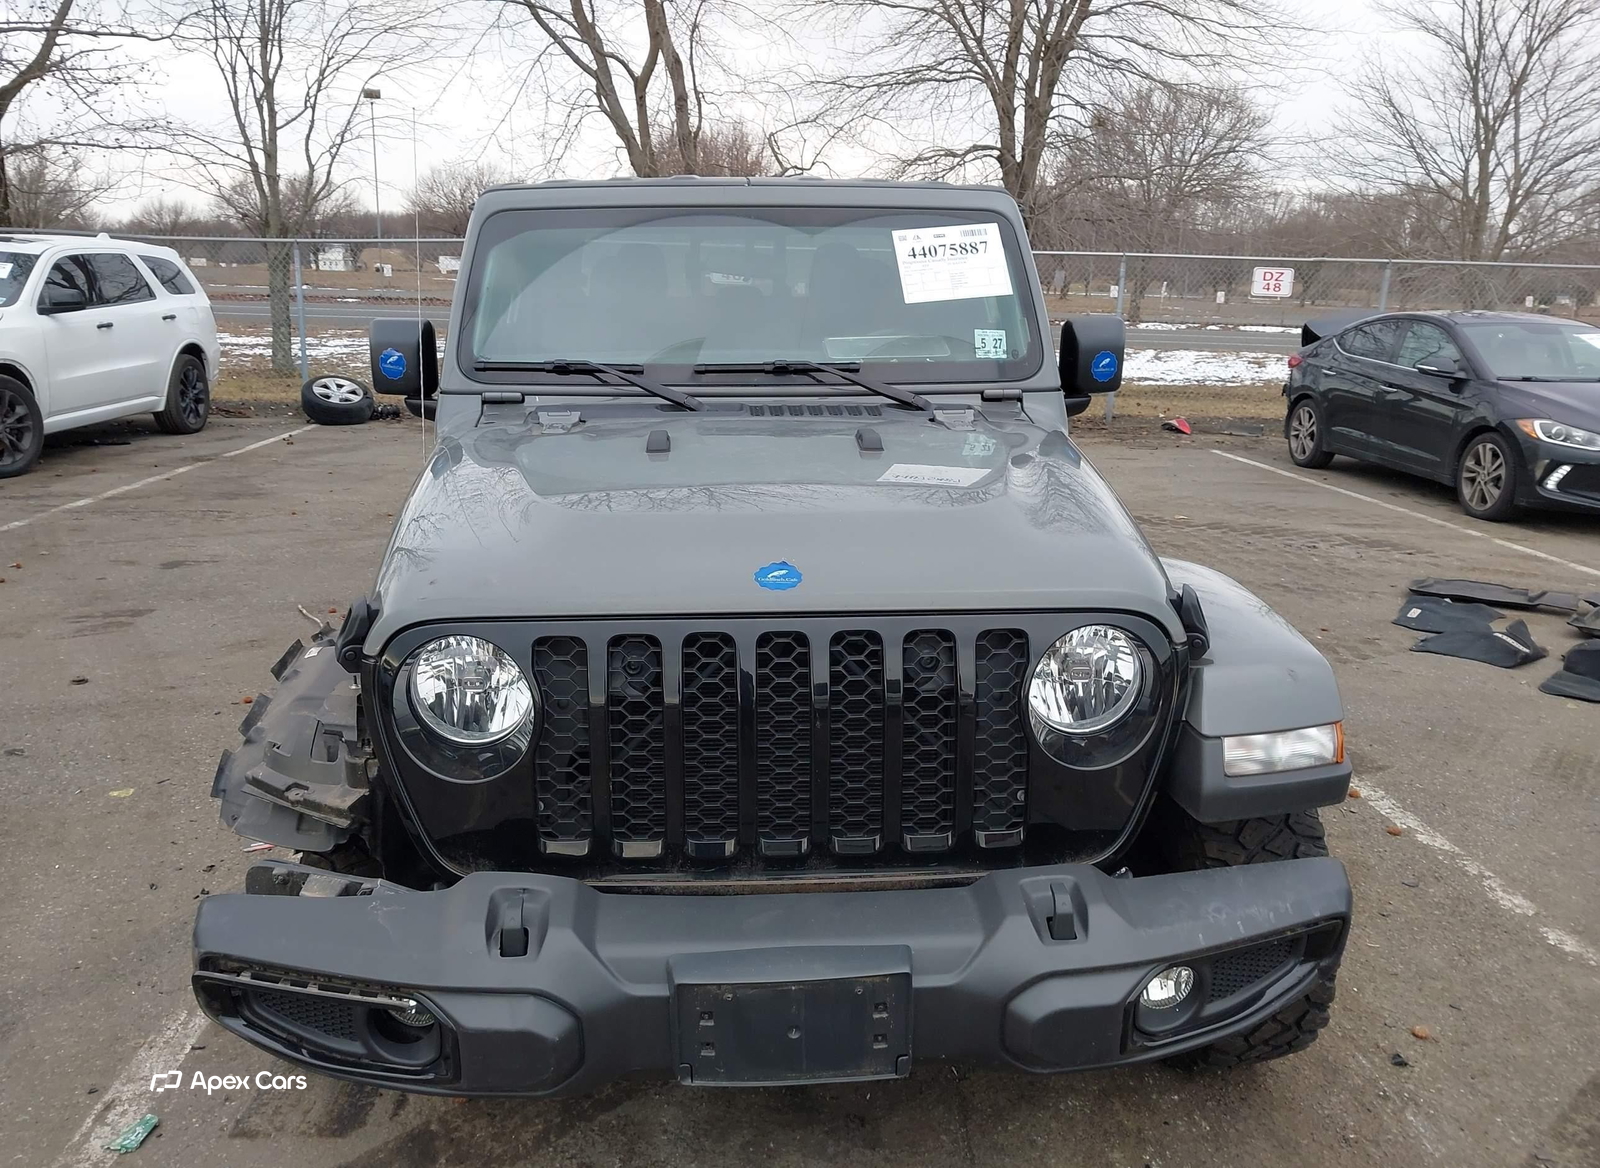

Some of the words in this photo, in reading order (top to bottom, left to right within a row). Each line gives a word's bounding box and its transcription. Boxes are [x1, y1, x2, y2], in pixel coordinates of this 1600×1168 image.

[908, 241, 988, 259] 44075887
[1263, 271, 1285, 282] DZ
[1262, 282, 1282, 292] 48
[981, 338, 986, 349] 5
[992, 338, 1003, 349] 27
